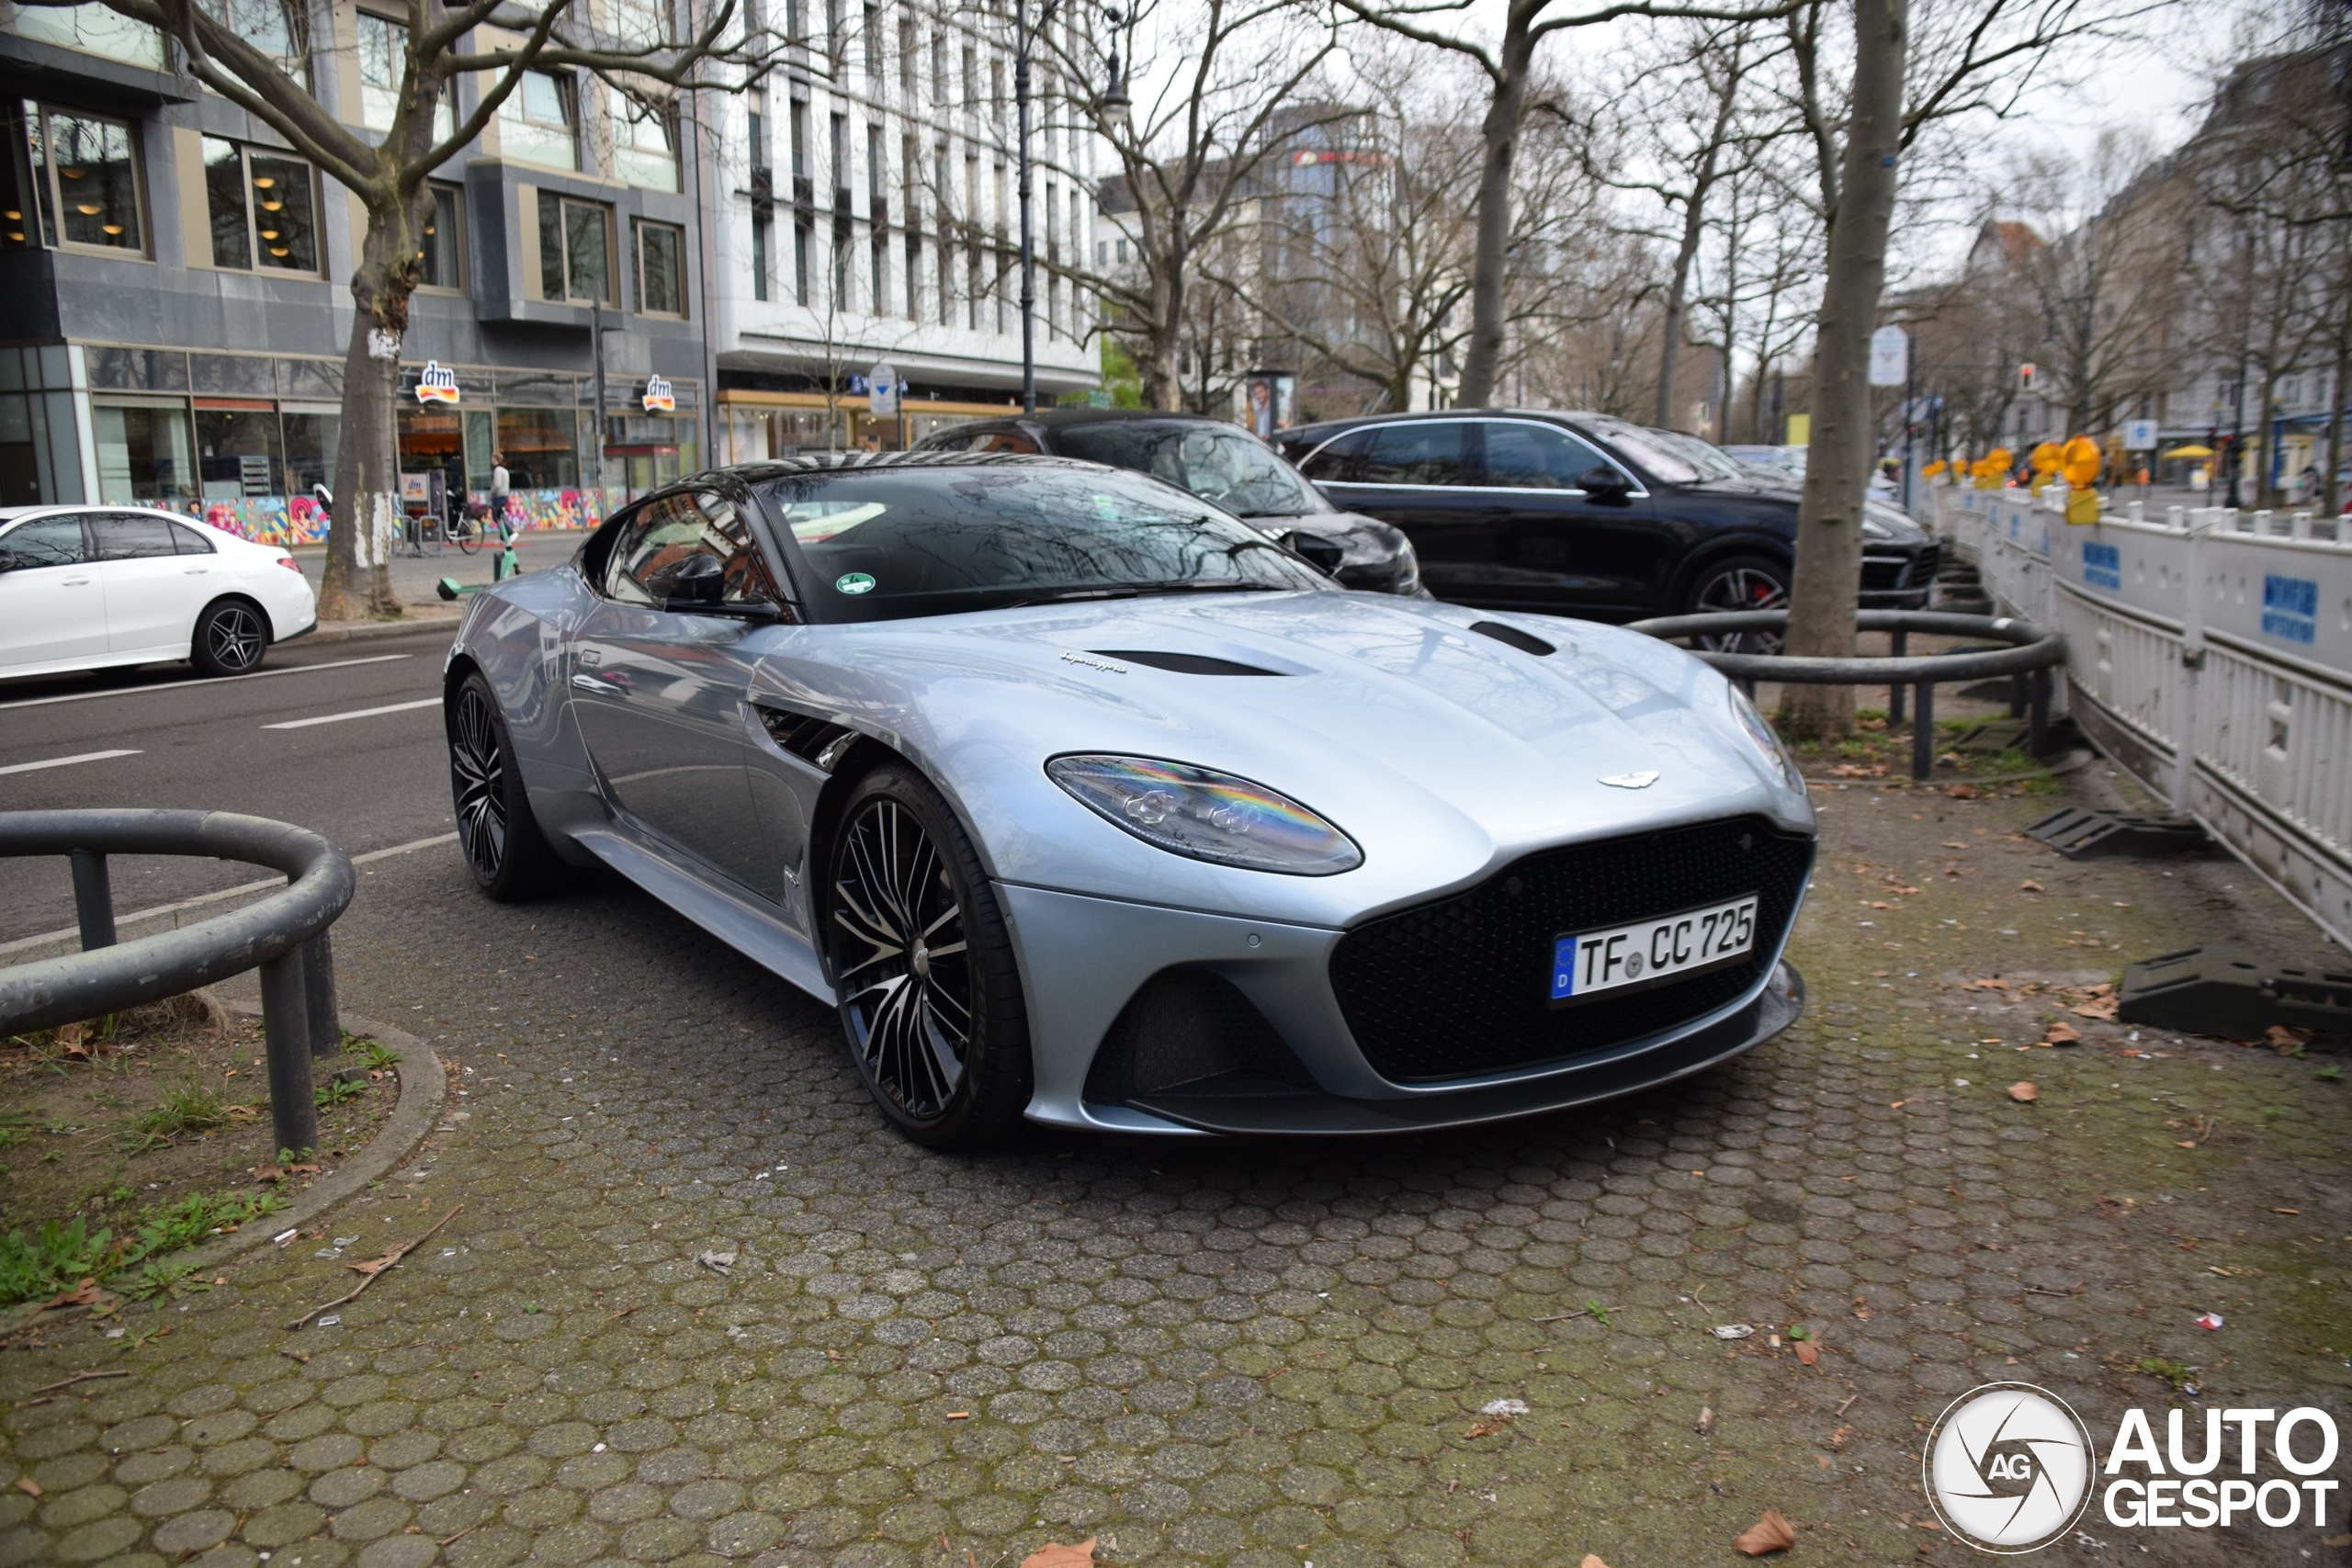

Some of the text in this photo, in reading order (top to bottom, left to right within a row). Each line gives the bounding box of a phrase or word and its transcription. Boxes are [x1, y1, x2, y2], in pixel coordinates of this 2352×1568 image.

[424, 364, 452, 386] dm
[650, 377, 670, 396] dm
[408, 479, 422, 490] dm
[1581, 902, 1755, 986] TF CC 725
[1557, 974, 1568, 988] D
